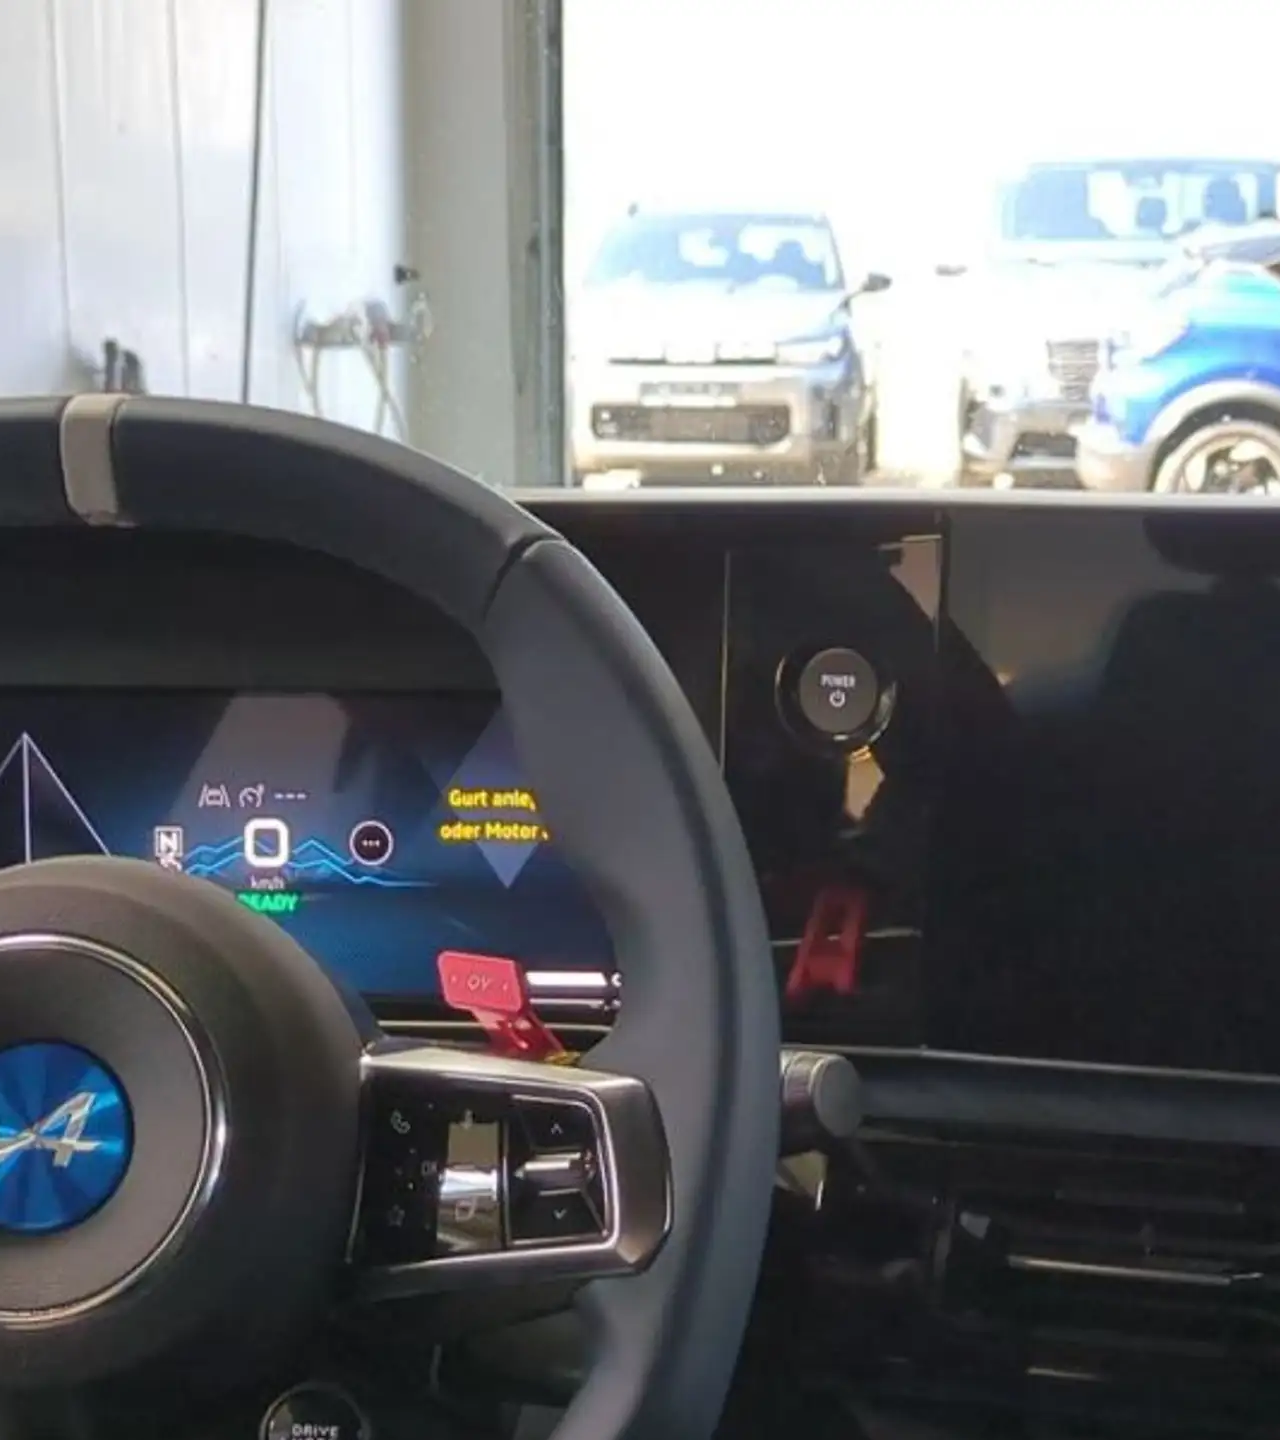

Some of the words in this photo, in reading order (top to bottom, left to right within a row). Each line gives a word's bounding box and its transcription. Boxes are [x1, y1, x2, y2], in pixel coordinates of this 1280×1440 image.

[821, 674, 856, 688] POWER
[449, 788, 488, 808] Gurt
[492, 788, 536, 812] anle
[440, 821, 480, 839] oder
[485, 821, 539, 840] Motor
[160, 831, 178, 851] N
[244, 818, 289, 868] 0
[250, 874, 286, 890] km/h
[292, 1423, 340, 1438] DRIVE
